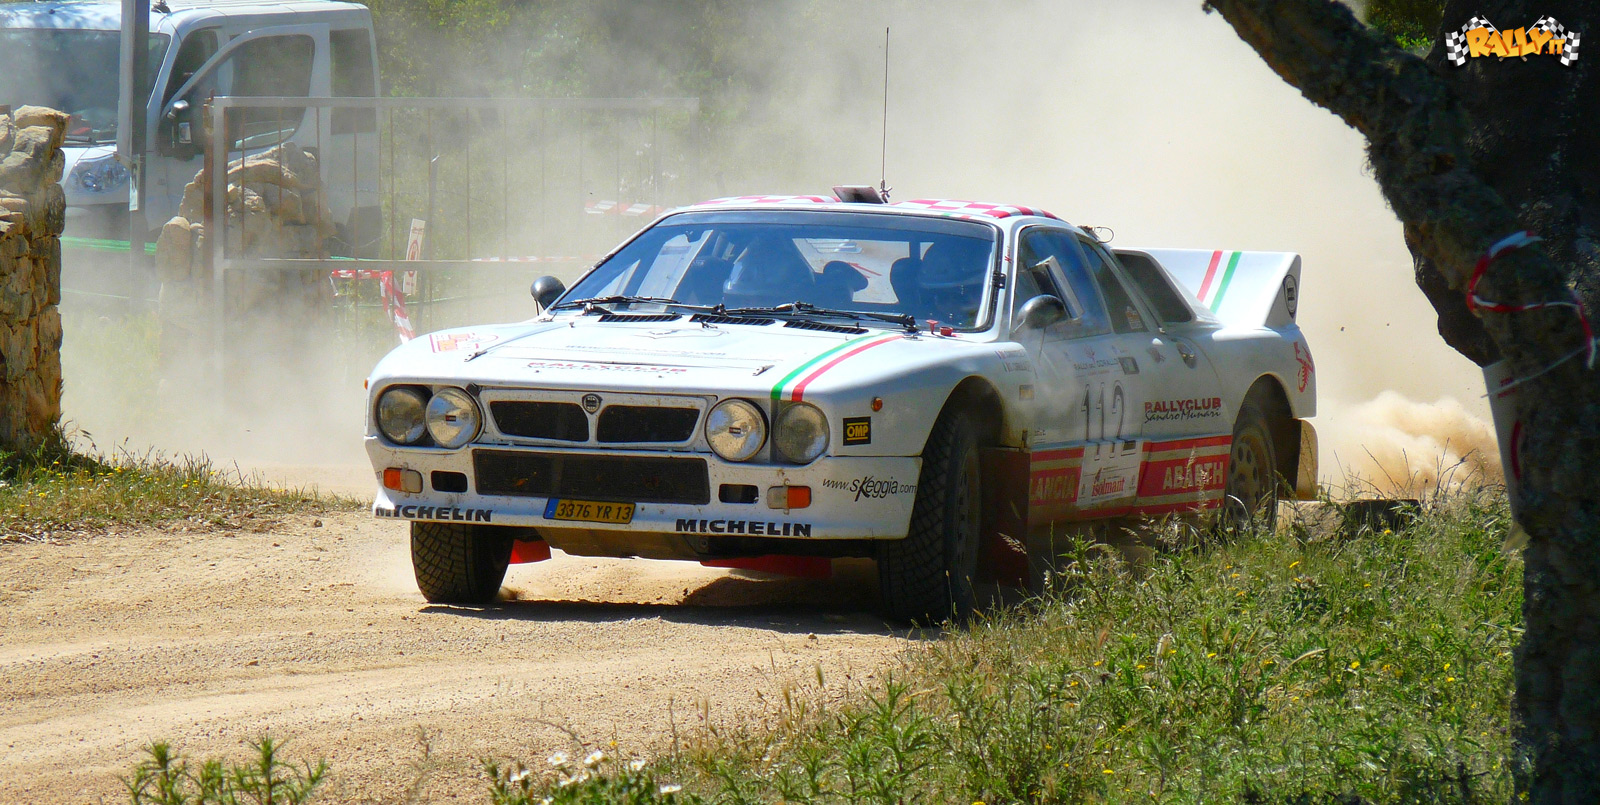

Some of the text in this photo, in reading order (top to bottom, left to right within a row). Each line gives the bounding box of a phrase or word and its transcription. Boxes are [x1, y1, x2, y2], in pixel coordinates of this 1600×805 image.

[1144, 397, 1222, 413] RALLYCLUB
[846, 423, 869, 438] OMP
[1162, 461, 1224, 491] ABARTH
[375, 504, 493, 522] MICHELIN
[596, 505, 612, 519] YR
[616, 506, 632, 520] 13
[675, 518, 812, 538] MICHELIN
